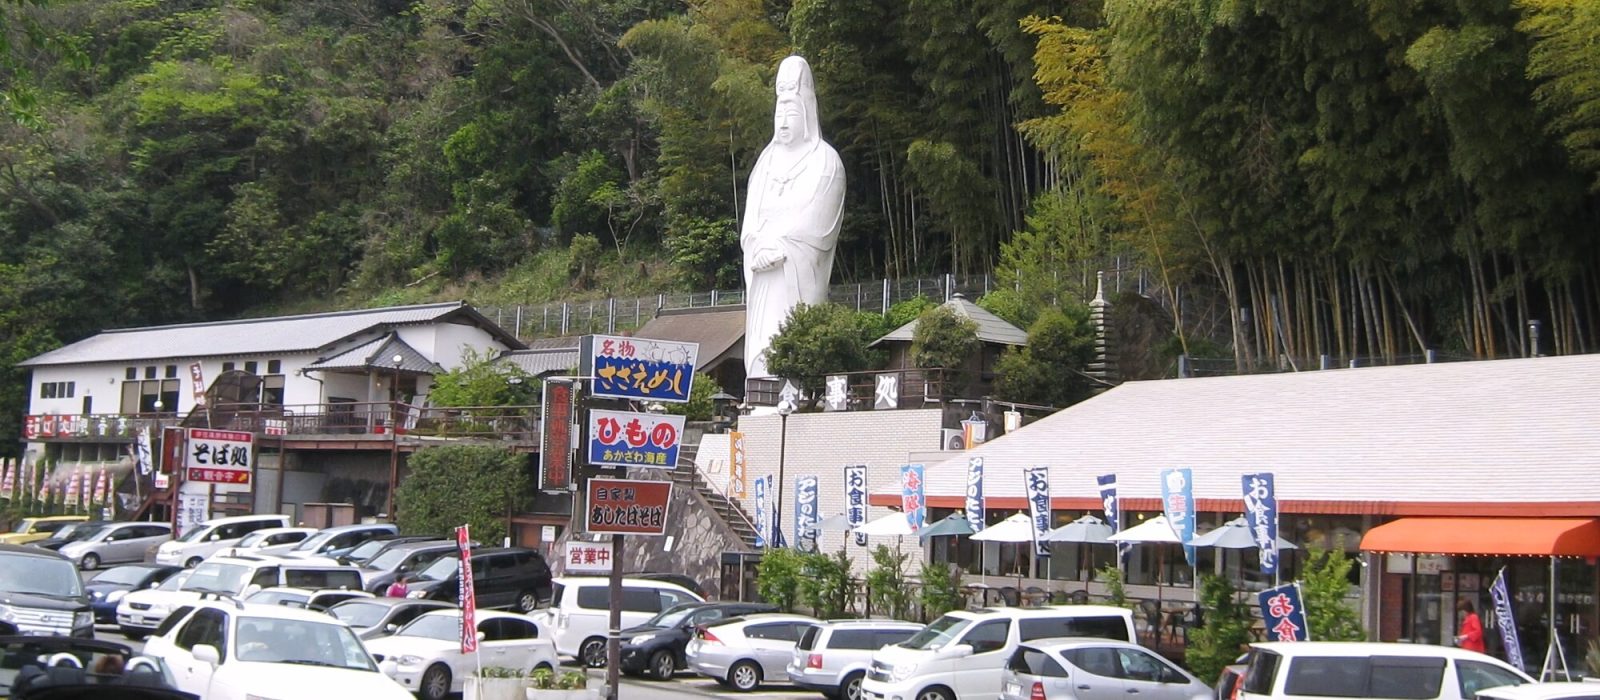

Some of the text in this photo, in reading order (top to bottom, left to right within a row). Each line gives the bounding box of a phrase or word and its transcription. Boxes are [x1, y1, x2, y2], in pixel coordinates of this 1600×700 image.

[600, 339, 635, 357] 名物
[598, 361, 685, 396] さざえめし
[779, 375, 898, 411] 食事処
[597, 417, 676, 448] ひもの
[192, 443, 247, 467] そば処
[603, 449, 667, 465] あかざわ海産
[596, 487, 635, 501] 自家製
[966, 458, 982, 532] アジのたた
[591, 504, 663, 527] あしたばそば
[798, 477, 816, 551] アジのたた
[569, 547, 610, 566] 営業中
